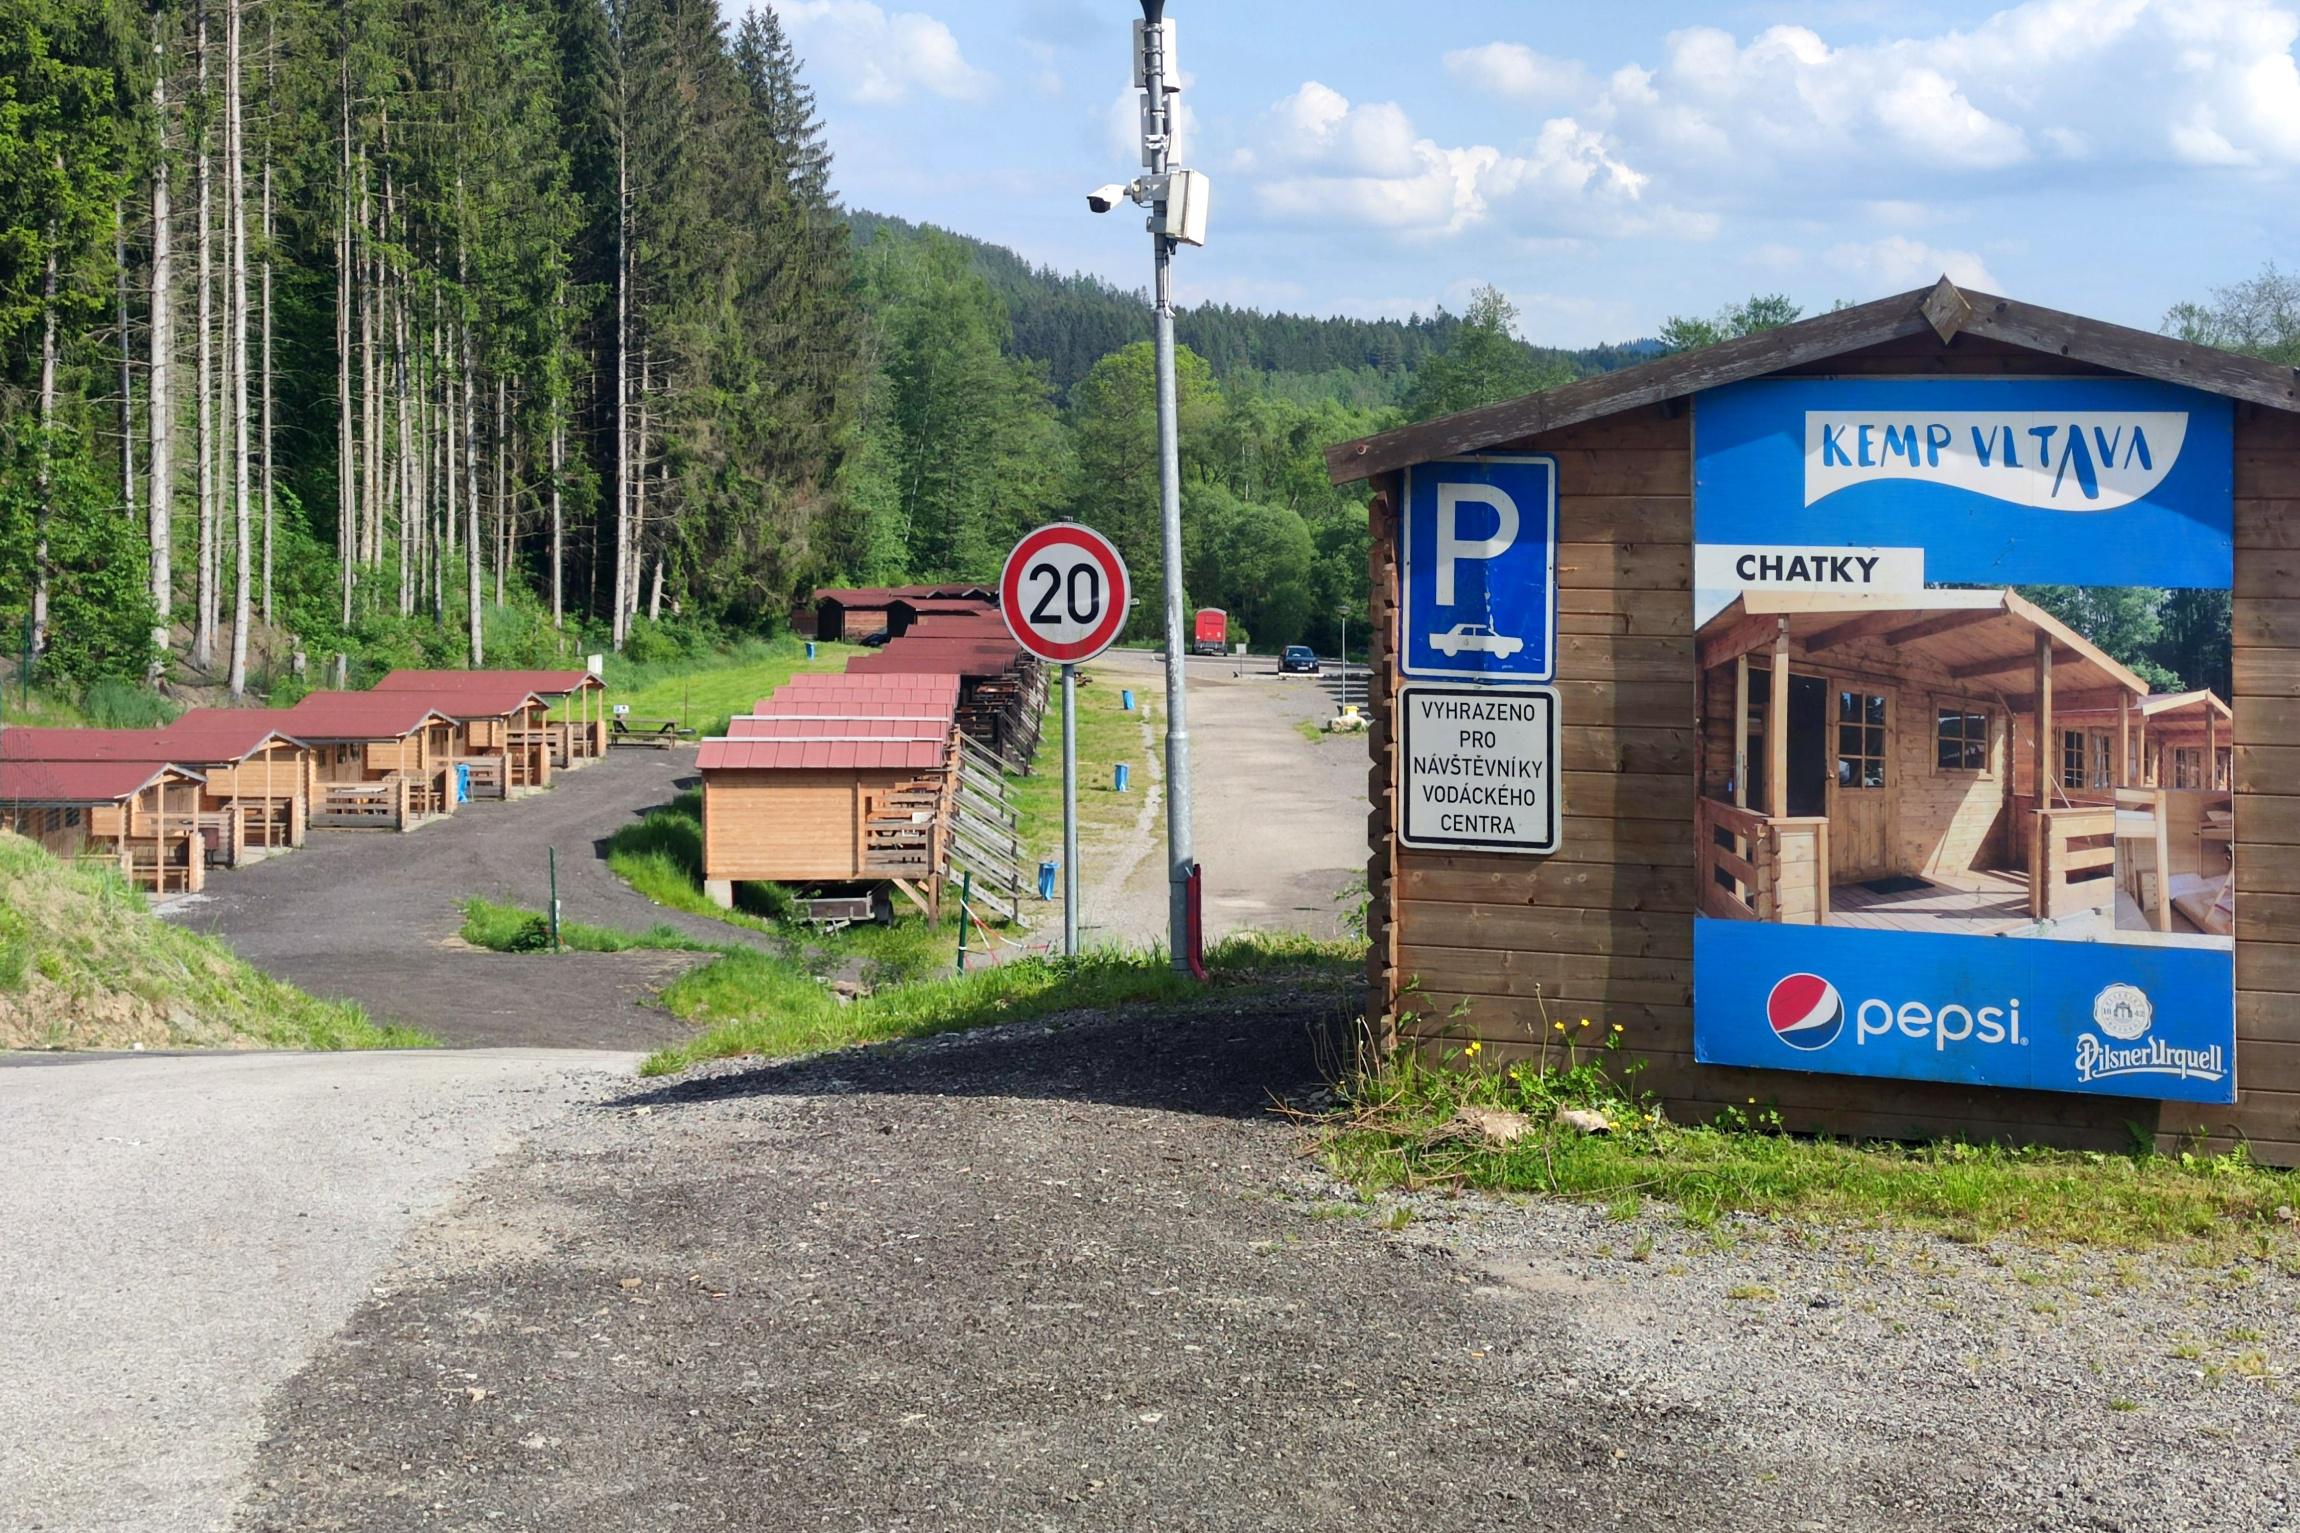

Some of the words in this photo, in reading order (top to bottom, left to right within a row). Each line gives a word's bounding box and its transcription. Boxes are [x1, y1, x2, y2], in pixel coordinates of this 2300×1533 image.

[1822, 423, 1951, 467] KEMP
[1971, 423, 2153, 500] VLTAVA
[1435, 482, 1520, 606] P
[1735, 553, 1880, 582] CHATKY
[1029, 563, 1100, 624] 20
[1421, 701, 1536, 721] VYHRAZENO
[1459, 730, 1496, 748] PRO
[1414, 753, 1543, 778] NÁVŠTĚVNÍKY
[1422, 782, 1536, 806] VODÁCKÉHO
[1440, 814, 1516, 834] CENTRA
[1857, 998, 2020, 1052] pepsi
[2075, 1033, 2150, 1083] Pilsner
[2148, 1035, 2223, 1080] Urquell
